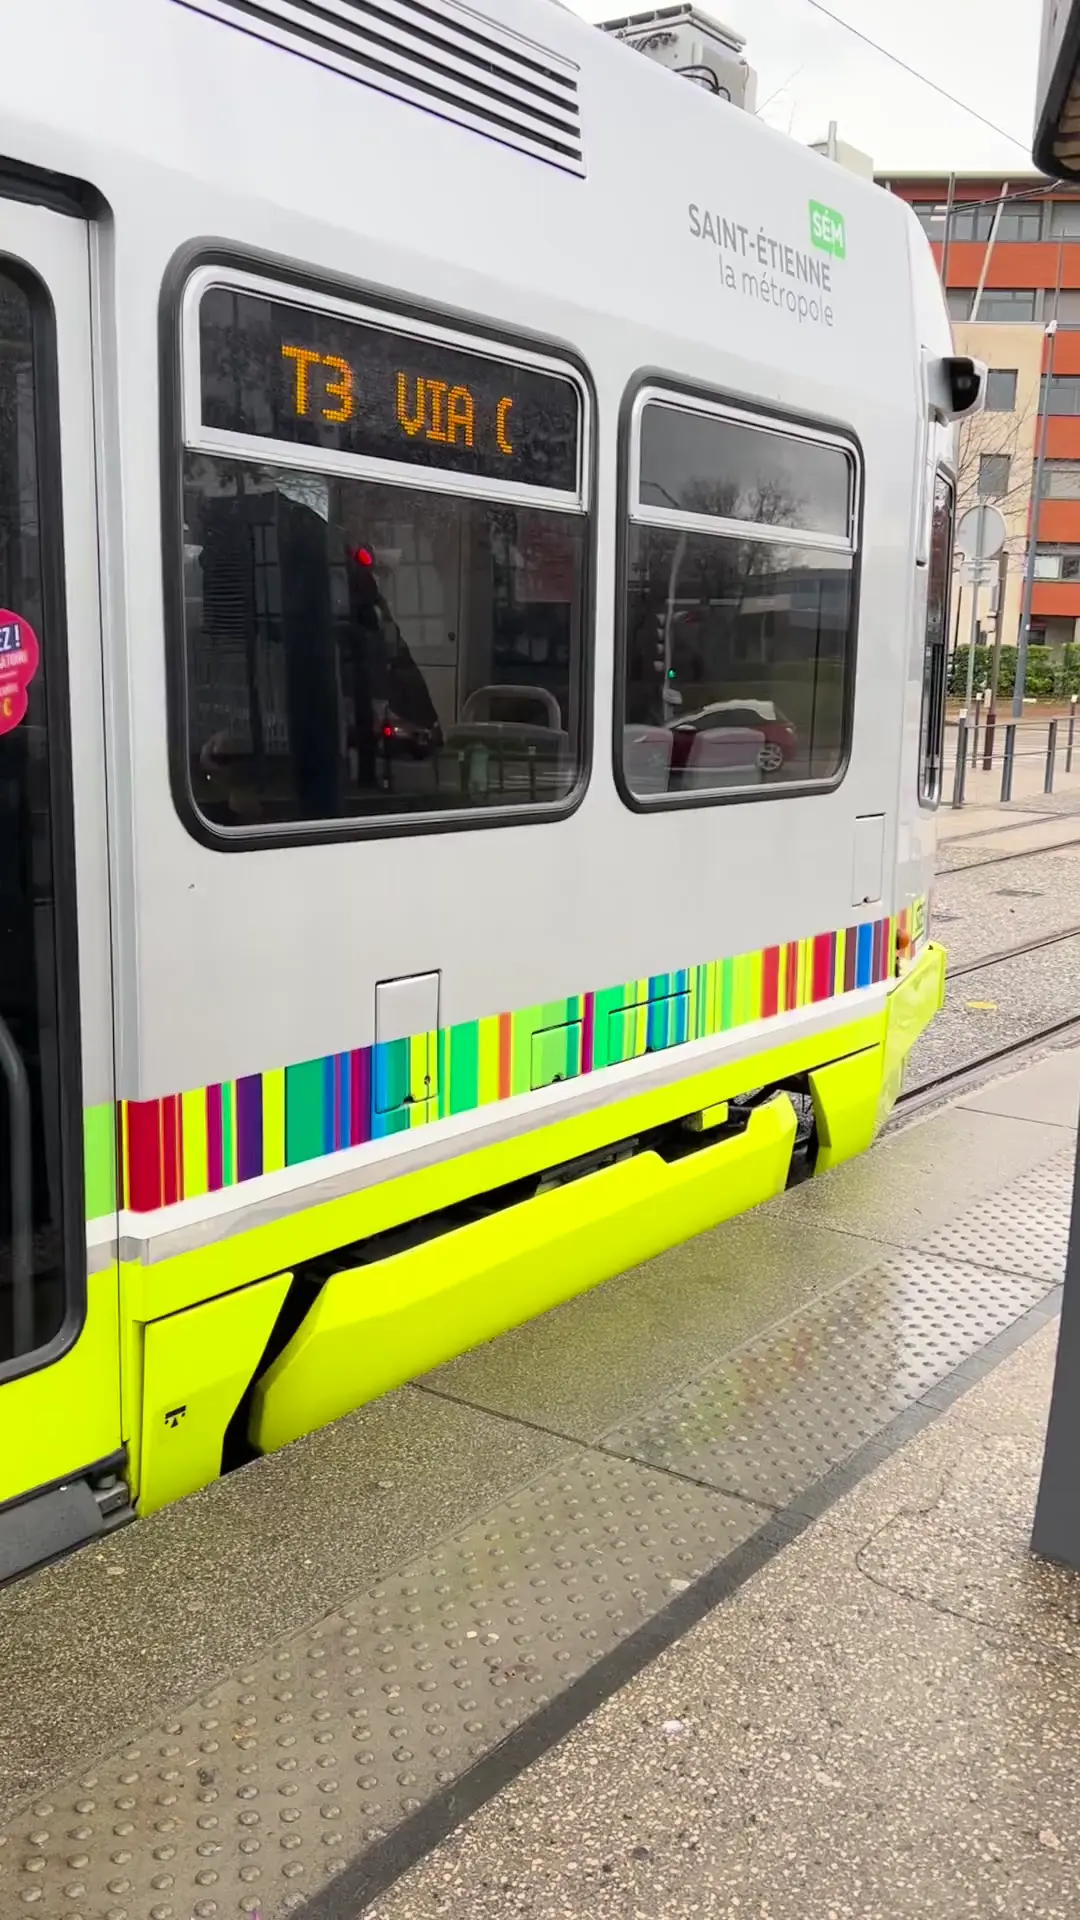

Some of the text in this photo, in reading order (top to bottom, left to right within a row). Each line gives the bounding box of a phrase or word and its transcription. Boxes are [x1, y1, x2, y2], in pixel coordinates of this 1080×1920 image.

[688, 203, 832, 293] SAINT-ÉTIENNE
[812, 210, 843, 248] SÉM
[719, 252, 834, 328] la métropole
[281, 344, 354, 424] T3
[396, 372, 474, 447] VIA
